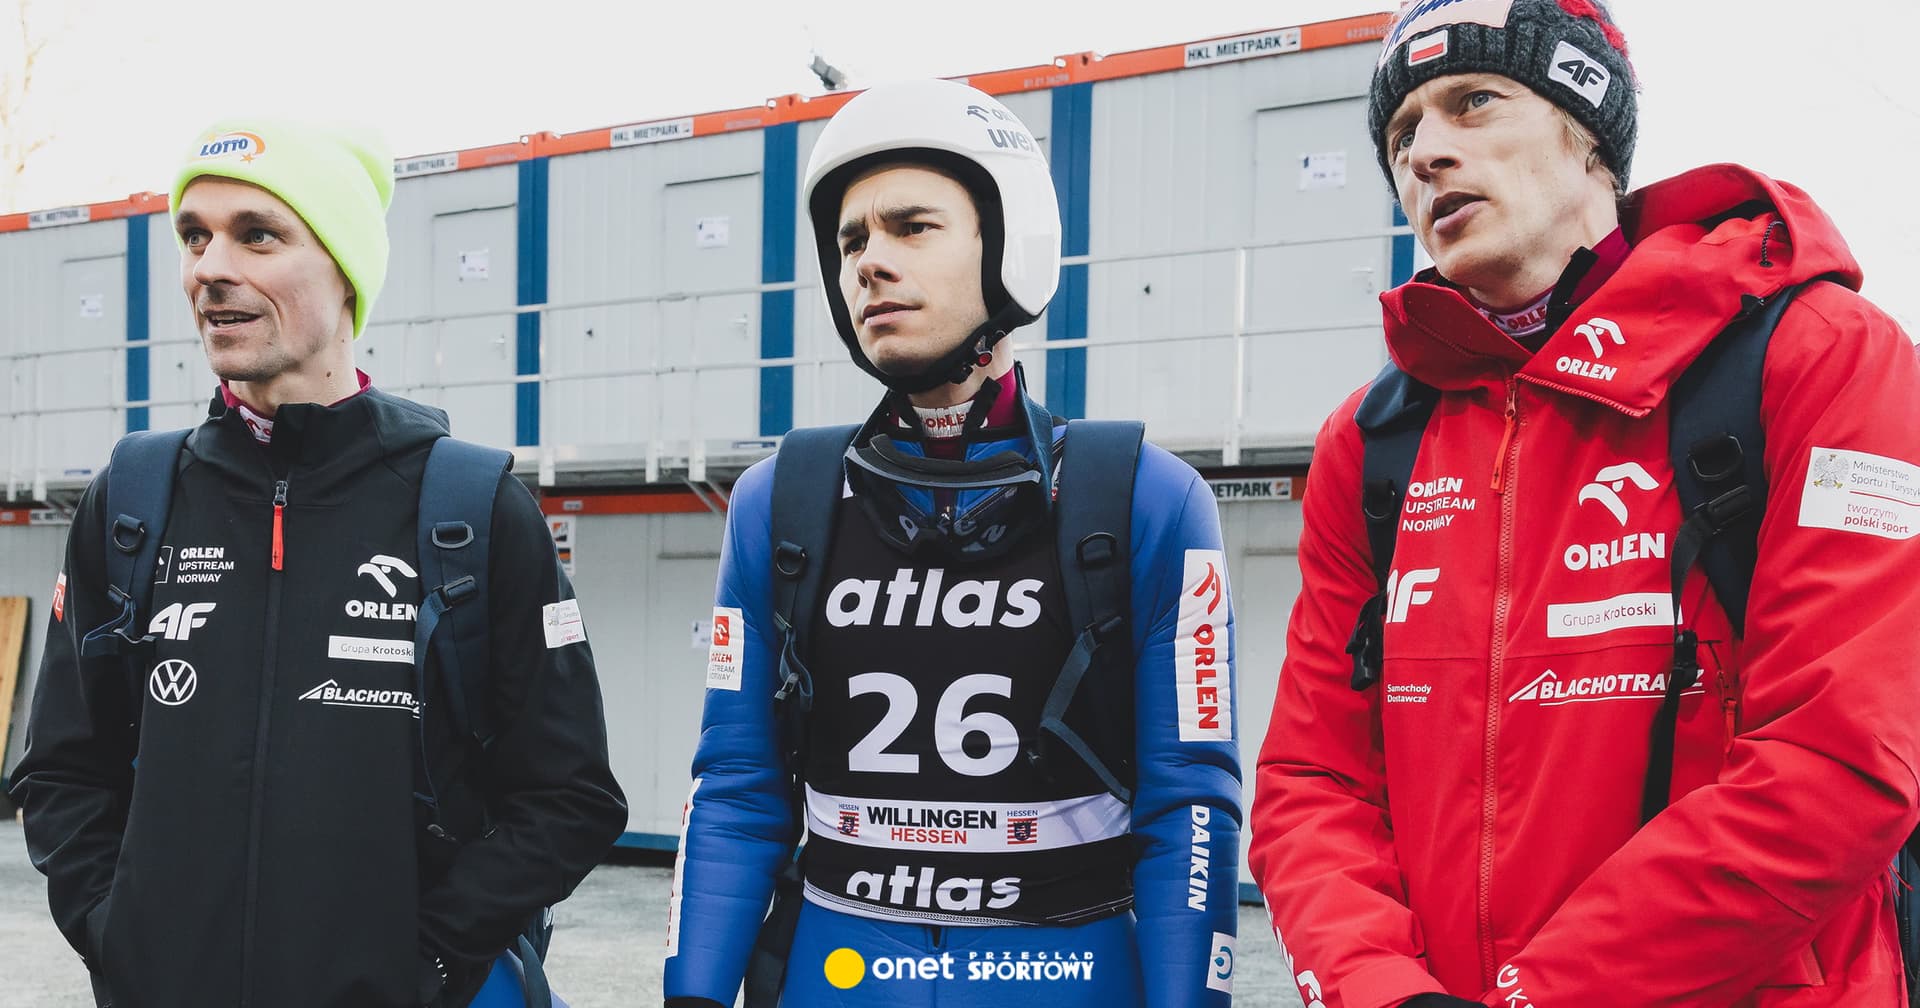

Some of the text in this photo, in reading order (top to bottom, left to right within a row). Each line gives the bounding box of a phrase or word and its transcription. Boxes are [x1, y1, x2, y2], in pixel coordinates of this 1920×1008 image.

[1188, 35, 1282, 61] HKL MIETPARK
[1557, 59, 1605, 88] 4F
[200, 139, 248, 156] LOTTO
[1507, 304, 1547, 330] ORLE
[1556, 356, 1617, 381] ORLEN
[924, 413, 968, 428] ORLE
[1853, 460, 1910, 481] Ministerstwo
[1408, 477, 1463, 498] ORLEN
[1851, 473, 1883, 488] Sportu
[1891, 481, 1920, 497] Turystyk
[1405, 496, 1476, 514] UPSTREAM
[1847, 503, 1900, 520] tworzymy
[1402, 514, 1455, 532] NORWAY
[1844, 516, 1909, 534] polski sport
[180, 547, 224, 559] ORLEN
[1563, 532, 1666, 571] ORLEN
[178, 561, 235, 571] UPSTREAM
[176, 573, 221, 584] NORWAY
[825, 568, 1045, 628] atlas
[345, 600, 418, 621] ORLEN
[1563, 602, 1656, 627] Grupa Krotoski
[148, 602, 217, 641] 4F
[340, 643, 414, 657] Grupa Krotoski
[1193, 623, 1219, 729] ORLEN
[322, 687, 419, 709] BLACHOTR
[1387, 684, 1432, 694] Samochody
[1387, 694, 1427, 703] Dostawcze
[848, 672, 1020, 777] 26
[838, 803, 860, 811] HESSEN
[1006, 809, 1038, 818] HESSEN
[866, 806, 997, 830] WILLINGEN
[891, 828, 967, 844] HESSEN
[1188, 805, 1211, 912] DAIKIN
[846, 865, 1021, 911] atlas
